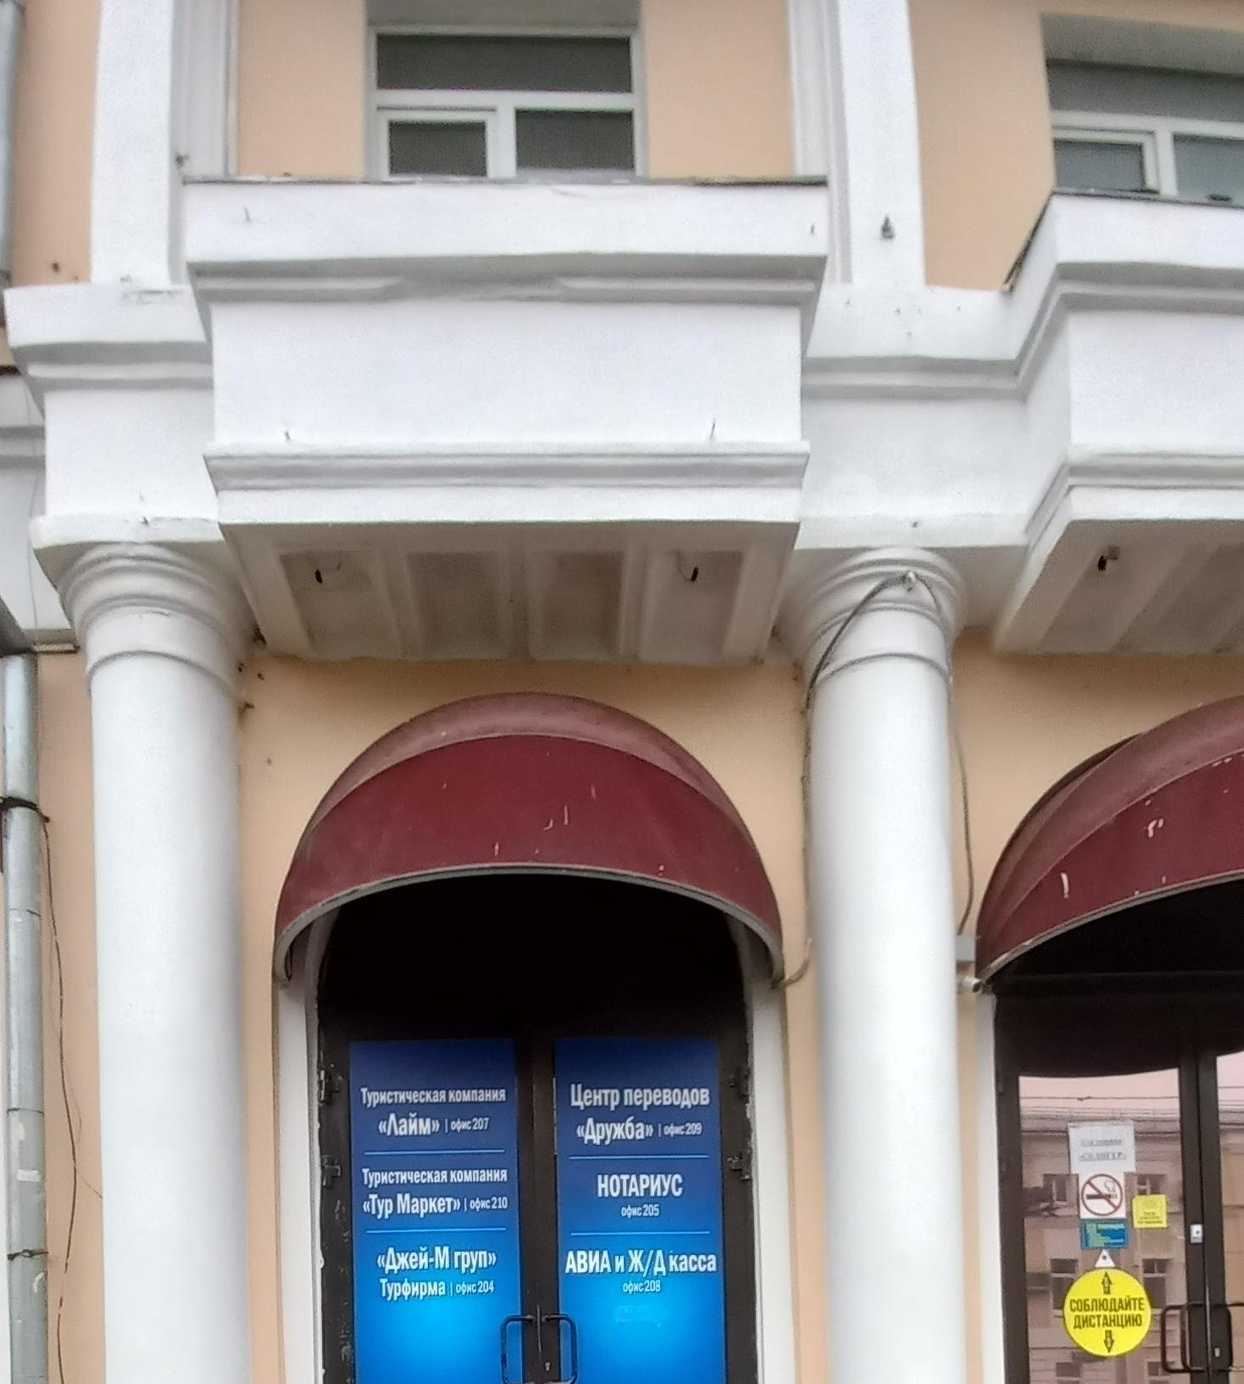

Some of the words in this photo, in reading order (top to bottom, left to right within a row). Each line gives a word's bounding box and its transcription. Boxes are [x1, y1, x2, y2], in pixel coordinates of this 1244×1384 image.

[361, 1088, 446, 1108] Туристическая
[449, 1089, 506, 1103] компания
[570, 1083, 620, 1111] Центр
[623, 1088, 710, 1110] переводов
[379, 1112, 440, 1136] «Лайм»
[451, 1119, 471, 1133] офис
[472, 1117, 489, 1131] 207
[576, 1116, 654, 1145] «Дружба»
[664, 1124, 685, 1137] офис
[685, 1123, 703, 1135] 209
[362, 1168, 447, 1188] Туристическая
[450, 1169, 508, 1184] компания
[597, 1173, 683, 1197] НОТАРИУС
[363, 1194, 393, 1219] «Тур
[397, 1193, 461, 1218] Маркет»
[470, 1199, 490, 1212] офис
[491, 1197, 508, 1209] 210
[621, 1205, 642, 1218] офис
[643, 1204, 660, 1217] 205
[377, 1246, 449, 1274] «Джей-М
[454, 1250, 497, 1274] груп»
[565, 1250, 612, 1274] АВИА
[614, 1255, 625, 1272] и
[628, 1249, 667, 1278] Ж/Д
[669, 1253, 717, 1272] касса
[380, 1278, 446, 1300] Турфирма
[455, 1281, 476, 1296] офис
[477, 1280, 495, 1293] 204
[623, 1281, 644, 1294] офис
[1069, 1296, 1145, 1312] СОБЛЮДАЙТЕ
[1073, 1314, 1142, 1329] ДИСТАНЦИЮ
